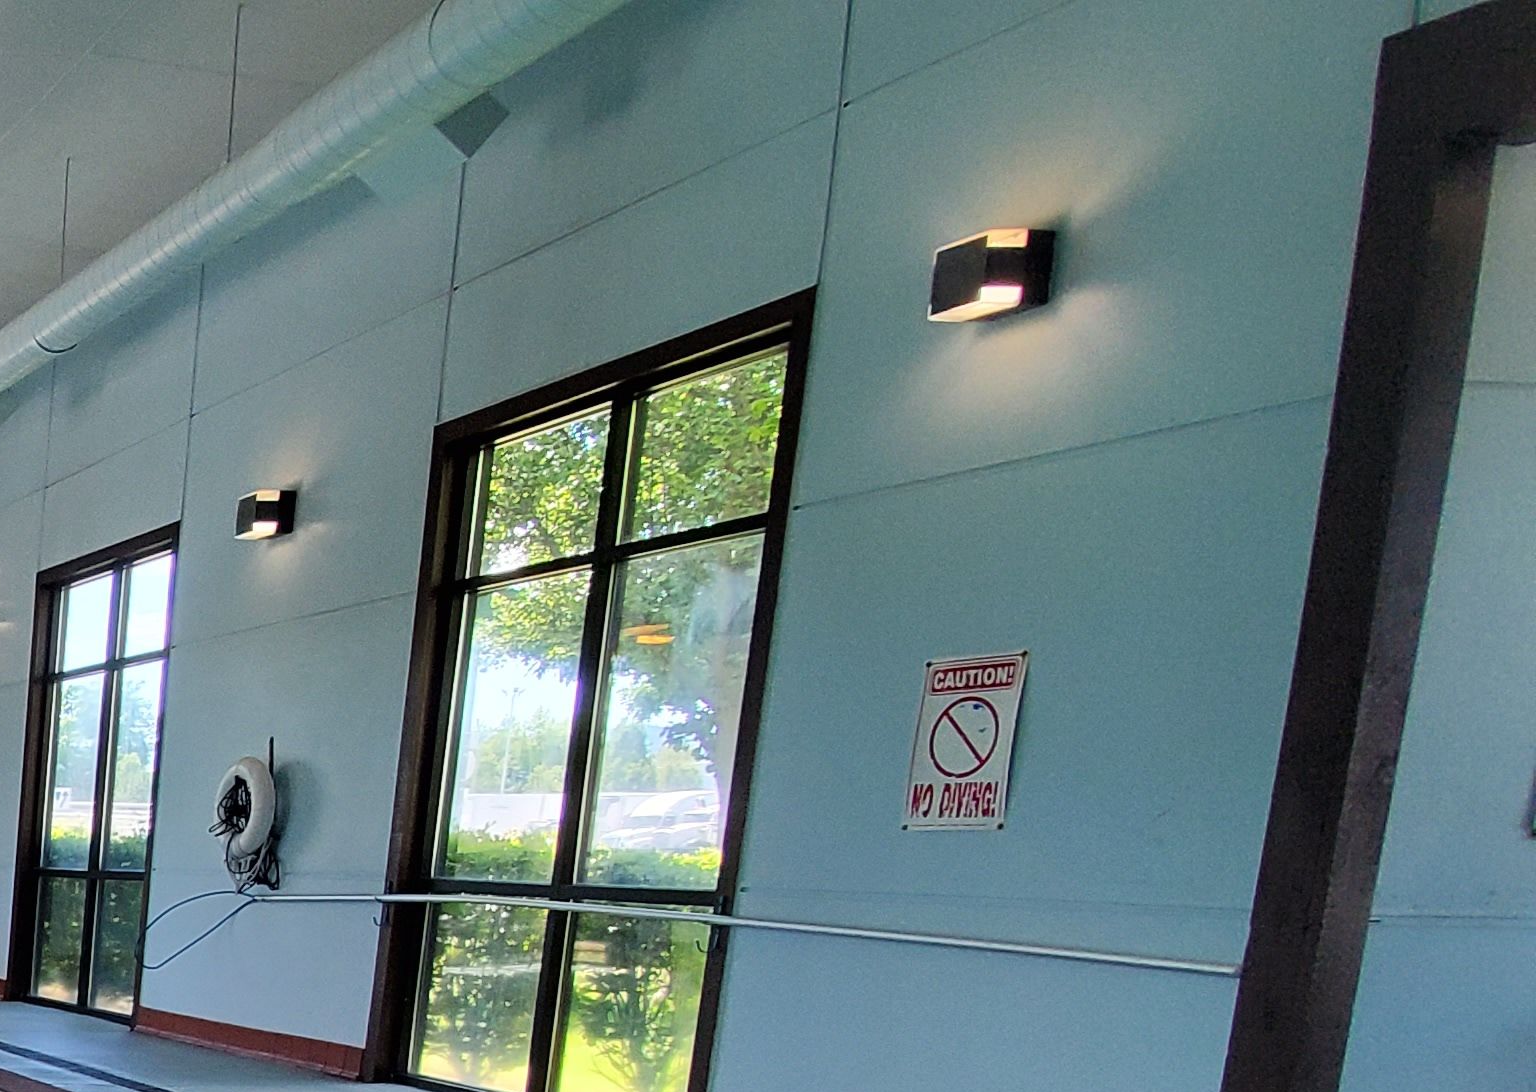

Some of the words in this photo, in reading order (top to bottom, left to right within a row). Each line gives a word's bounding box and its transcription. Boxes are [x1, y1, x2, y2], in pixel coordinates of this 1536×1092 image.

[933, 666, 1014, 690] CAUTION!
[910, 783, 934, 819] NO
[938, 780, 999, 819] DIVING!
